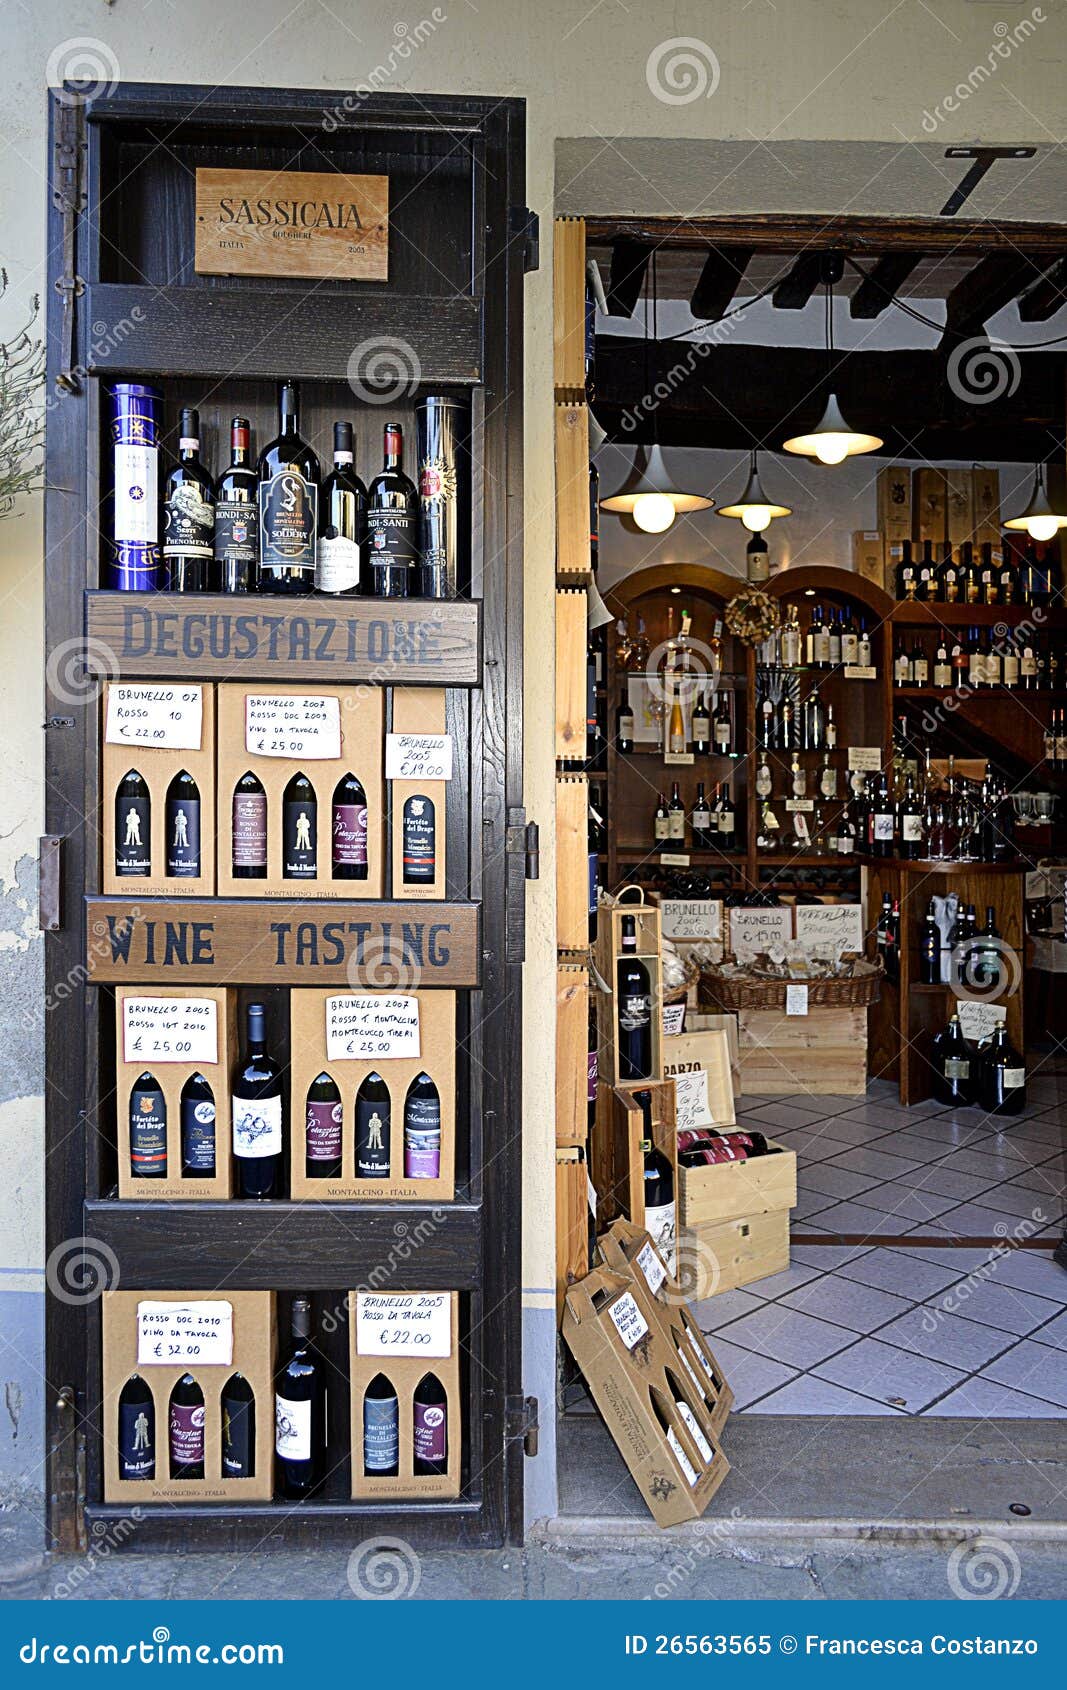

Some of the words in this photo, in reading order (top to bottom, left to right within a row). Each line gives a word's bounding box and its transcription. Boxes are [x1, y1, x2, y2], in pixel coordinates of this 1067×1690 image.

[219, 197, 364, 229] SASSICAIA
[219, 240, 245, 249] ITALIA
[121, 604, 444, 665] DEGUSTAZIONE
[118, 689, 174, 701] BRUNELLO
[250, 699, 295, 708] BRUNELLO
[302, 700, 326, 709] 2007
[117, 707, 149, 718] ROSSO
[250, 711, 277, 719] ROSSO
[397, 736, 445, 749] BRUNELLO
[664, 903, 717, 916] BRUNELLO
[105, 915, 215, 967] WINE
[270, 921, 452, 968] TASTING
[128, 1005, 178, 1014] BRUNELLO
[185, 1006, 210, 1015] 2005
[331, 1000, 380, 1011] BRUNELLO
[385, 1000, 409, 1009] 2007
[331, 1015, 357, 1024] ROSSO
[128, 1020, 155, 1029] ROSSO
[183, 1022, 206, 1031] 2010
[327, 1188, 384, 1197] MONTALCINO
[390, 1189, 417, 1197] ITALIA
[361, 1296, 413, 1307] BRUNELLO
[417, 1296, 445, 1308] 2005
[142, 1314, 170, 1323] ROSSO
